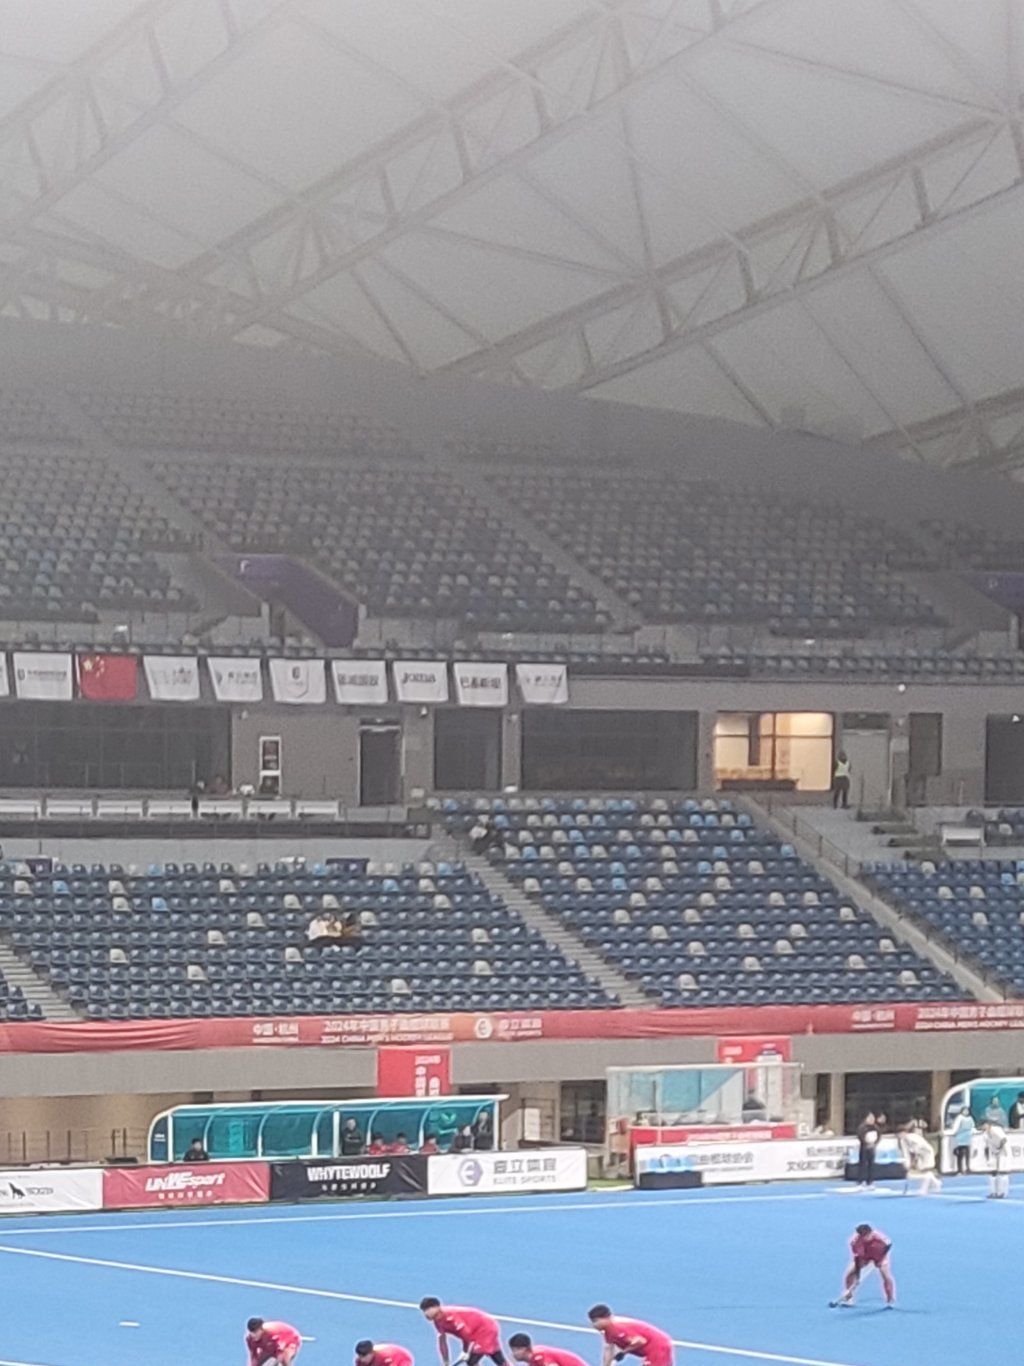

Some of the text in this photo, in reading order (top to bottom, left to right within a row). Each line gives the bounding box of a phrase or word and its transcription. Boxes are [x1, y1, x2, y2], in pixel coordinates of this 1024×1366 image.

[307, 1163, 391, 1182] WHYTEWOOLF
[493, 1175, 557, 1186] ELITE SPORTS
